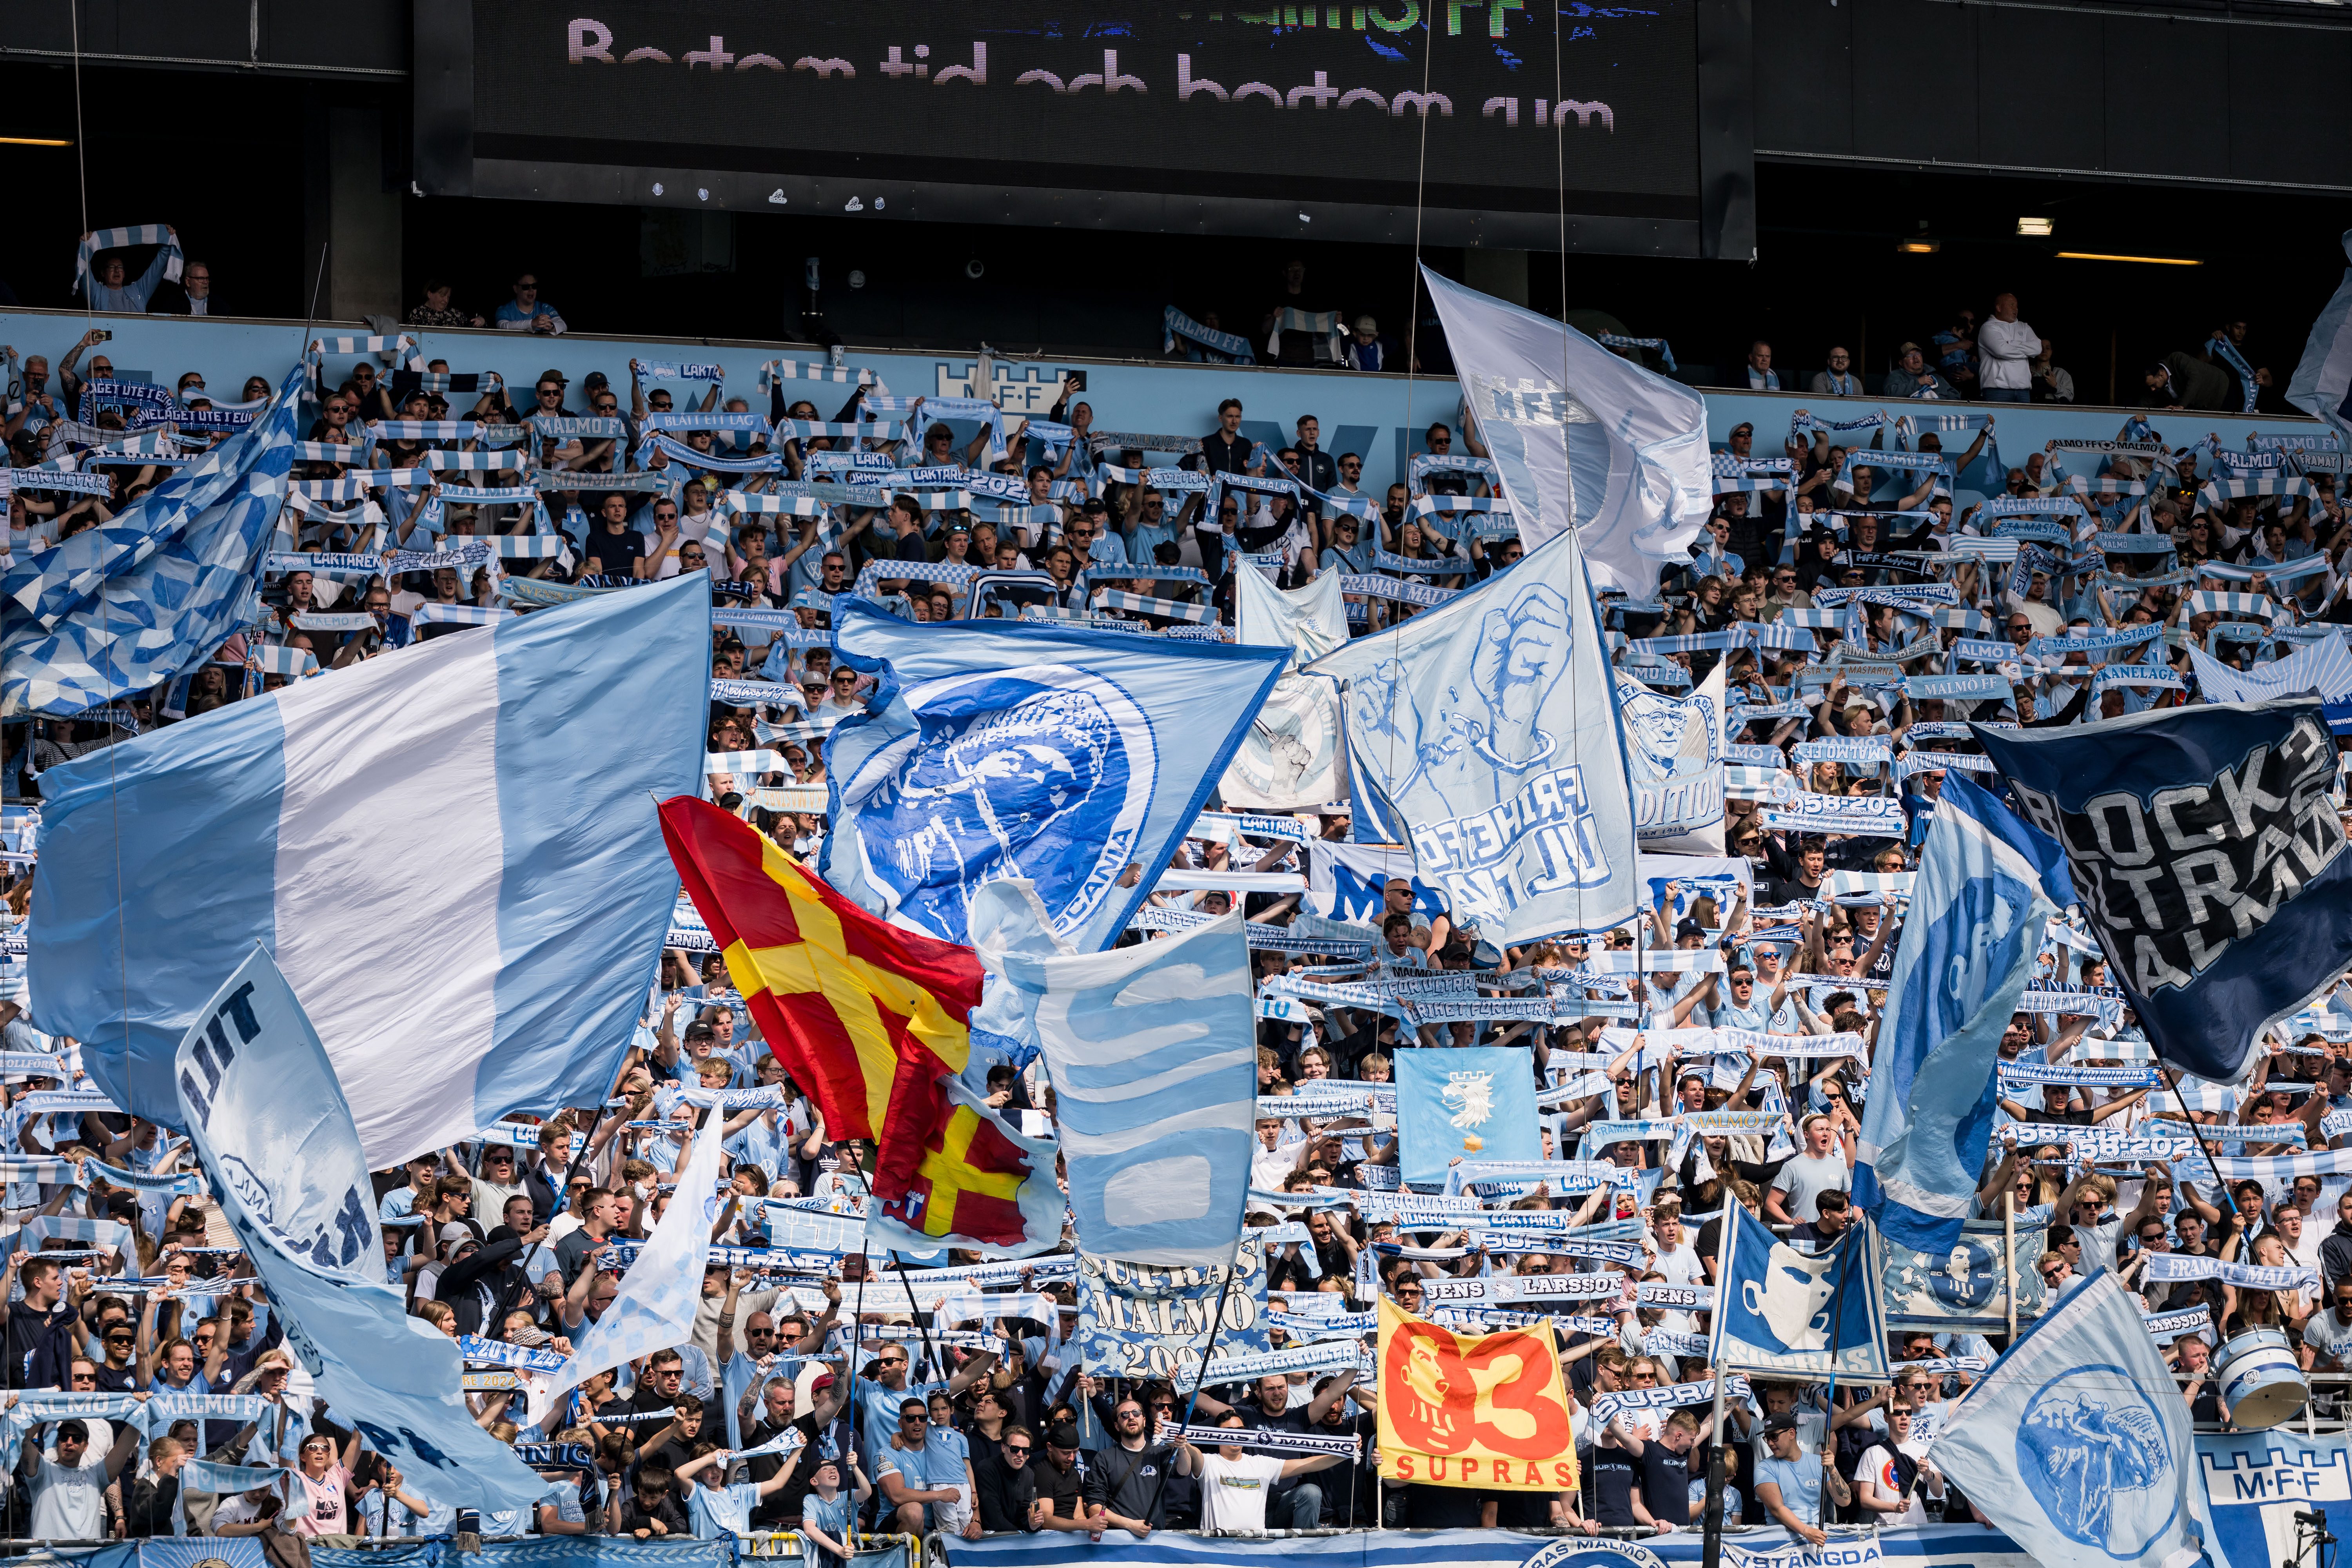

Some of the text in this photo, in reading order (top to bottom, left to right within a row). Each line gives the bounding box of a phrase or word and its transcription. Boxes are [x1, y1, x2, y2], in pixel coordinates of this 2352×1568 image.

[1222, 331, 1245, 351] FF
[123, 385, 143, 398] UTE
[199, 411, 223, 423] UTE
[665, 413, 754, 426] BLÅTT ETT LAG
[1180, 437, 1201, 450] FF
[2053, 439, 2158, 452] ALMÖ FF MALMÖ
[2256, 435, 2316, 450] MALMÖ
[1857, 450, 1940, 468] MALMÖ FF
[620, 474, 640, 487] FF
[1258, 479, 1296, 491] MALMÖ
[846, 487, 877, 495] HEJA
[857, 494, 877, 504] BLÅE
[980, 486, 999, 496] Stadion
[2053, 497, 2073, 510] FF
[1480, 515, 1517, 531] MAL
[1856, 553, 1917, 568] MFF Support
[519, 584, 573, 602] SVENSKA
[1339, 573, 1401, 596] FRAMÅT
[1665, 596, 1688, 605] FF
[305, 616, 367, 626] MALMÖ FF
[712, 610, 790, 624] TBOLLFÖRENING
[785, 630, 831, 643] MAL
[2053, 639, 2097, 648] MESTA
[1840, 639, 1934, 660] HIMMELSBLÅTT
[1957, 645, 2004, 658] ALMÖ
[1664, 668, 1687, 682] FF
[710, 681, 763, 698] Malmö
[1924, 677, 1998, 696] MALMÖ FF
[1725, 746, 1764, 761] LMÖ
[1804, 744, 1882, 762] MALMÖ FF
[1637, 773, 1721, 827] DITION
[2011, 744, 2288, 867] BLOCK
[1841, 816, 1887, 833] 1910
[1363, 992, 1392, 1007] FF
[2016, 993, 2099, 1013] LLFÖRENING
[1413, 1000, 1467, 1020] FRIHET
[1470, 998, 1501, 1016] FÖR
[1587, 1075, 1608, 1093] FF
[2079, 1069, 2147, 1082] DOMINANS
[29, 1093, 72, 1107] MALMÖ
[1269, 1098, 1302, 1115] FÖR
[1689, 1112, 1759, 1129] MALMÖ
[1594, 1122, 1635, 1137] FRAMÅT
[2260, 1124, 2287, 1140] FF
[2118, 1152, 2140, 1160] Malmö
[2140, 1152, 2163, 1160] Stadion
[1398, 1212, 1570, 1232] NORRA LÄKTAREN
[708, 1247, 837, 1276] BLÅE
[1426, 1277, 1623, 1300] JENS LARSSON
[1642, 1286, 1697, 1306] JENS
[1092, 1283, 1256, 1335] MALMÖ
[1302, 1292, 1333, 1311] FF
[2144, 1310, 2209, 1334] LARSSON
[477, 1339, 559, 1367] 20 24
[1728, 1338, 1869, 1373] SUPRAS
[1259, 1351, 1301, 1374] FÖR
[483, 1375, 515, 1388] 2024
[1593, 1375, 1751, 1424] SUPRAS
[9, 1393, 110, 1425] MALMÖ
[1167, 1427, 1356, 1454] SUPRAS MALMÖ
[1397, 1455, 1574, 1488] SUPRAS
[1577, 1539, 1648, 1561] MALMÖ
